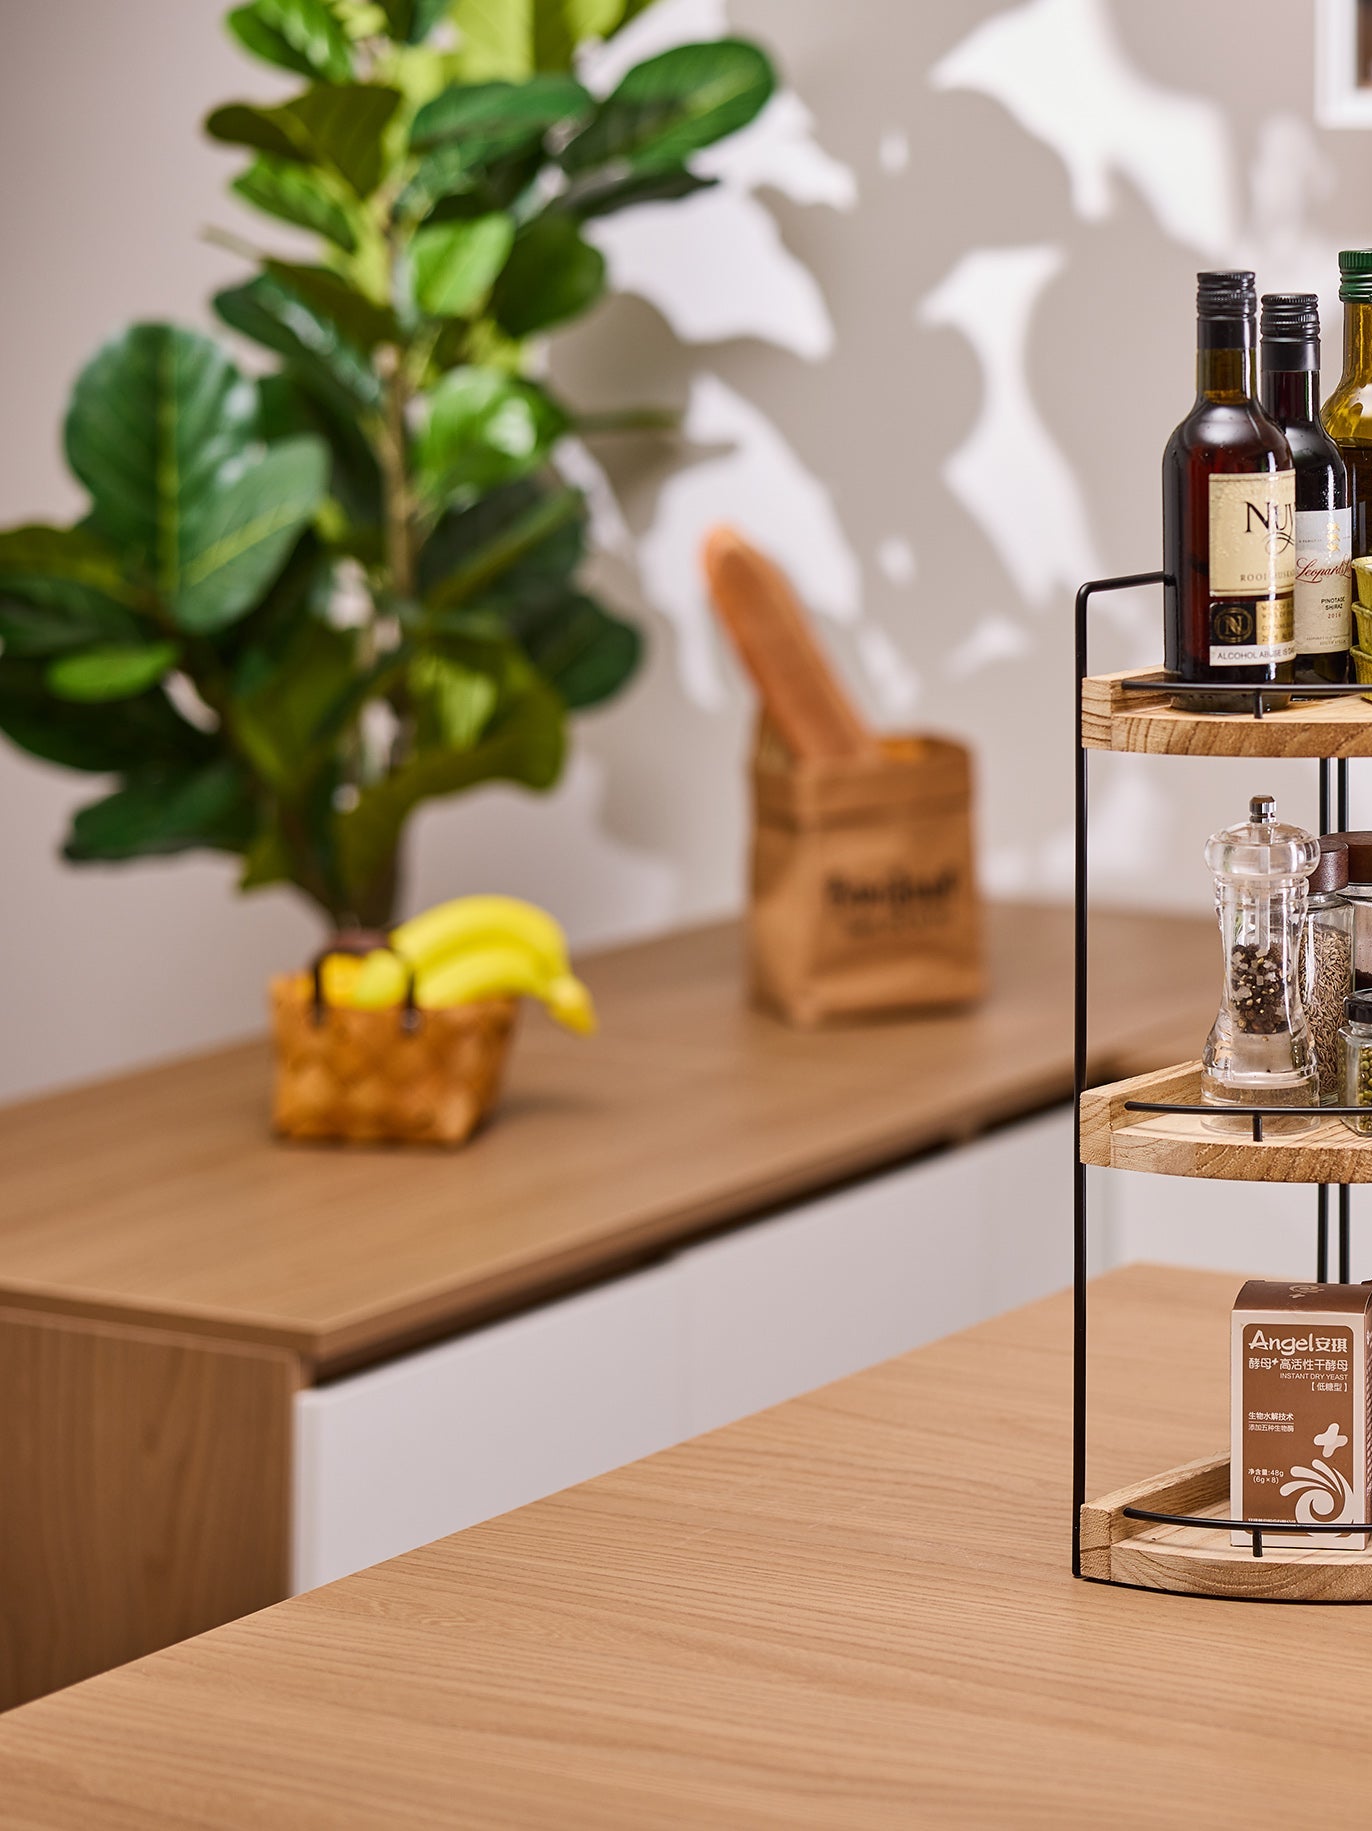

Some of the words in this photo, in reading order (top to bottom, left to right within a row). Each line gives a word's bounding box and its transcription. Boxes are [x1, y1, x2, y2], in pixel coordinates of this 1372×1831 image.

[1217, 651, 1257, 661] ALCOHOL
[1248, 1329, 1314, 1356] Angel
[1315, 1337, 1348, 1353] 安琪
[1280, 1372, 1309, 1380] INSTANT
[1310, 1373, 1325, 1381] DRY
[1326, 1373, 1349, 1381] YEAST
